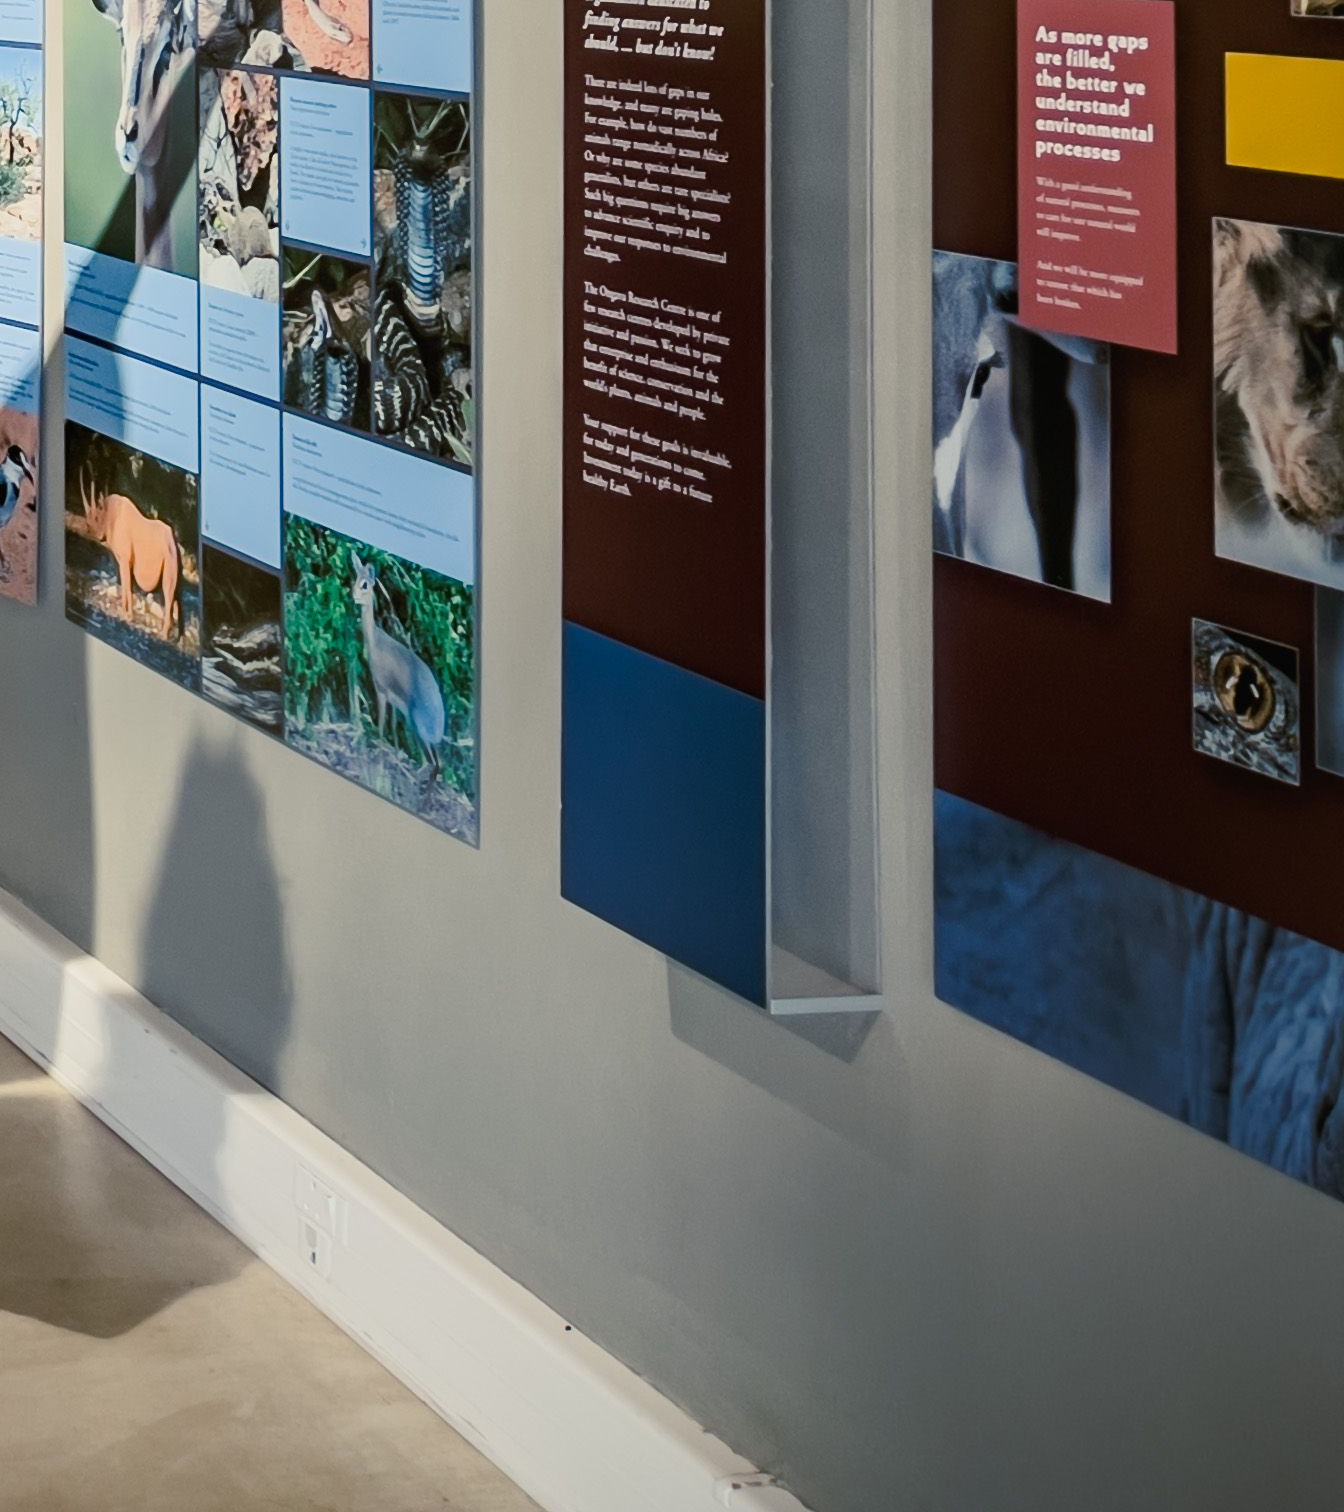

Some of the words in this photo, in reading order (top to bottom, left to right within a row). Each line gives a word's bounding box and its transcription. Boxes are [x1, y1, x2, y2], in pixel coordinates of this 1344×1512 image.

[699, 0, 709, 10] to
[1036, 26, 1057, 42] As
[1061, 31, 1103, 46] more
[1108, 35, 1149, 54] gaps
[1036, 52, 1062, 65] are
[1066, 49, 1115, 71] filled,
[1036, 69, 1061, 88] the
[1066, 71, 1118, 93] better
[1123, 82, 1145, 95] we
[1036, 93, 1130, 117] understand
[1036, 118, 1153, 142] environmental
[1036, 141, 1120, 162] processes
